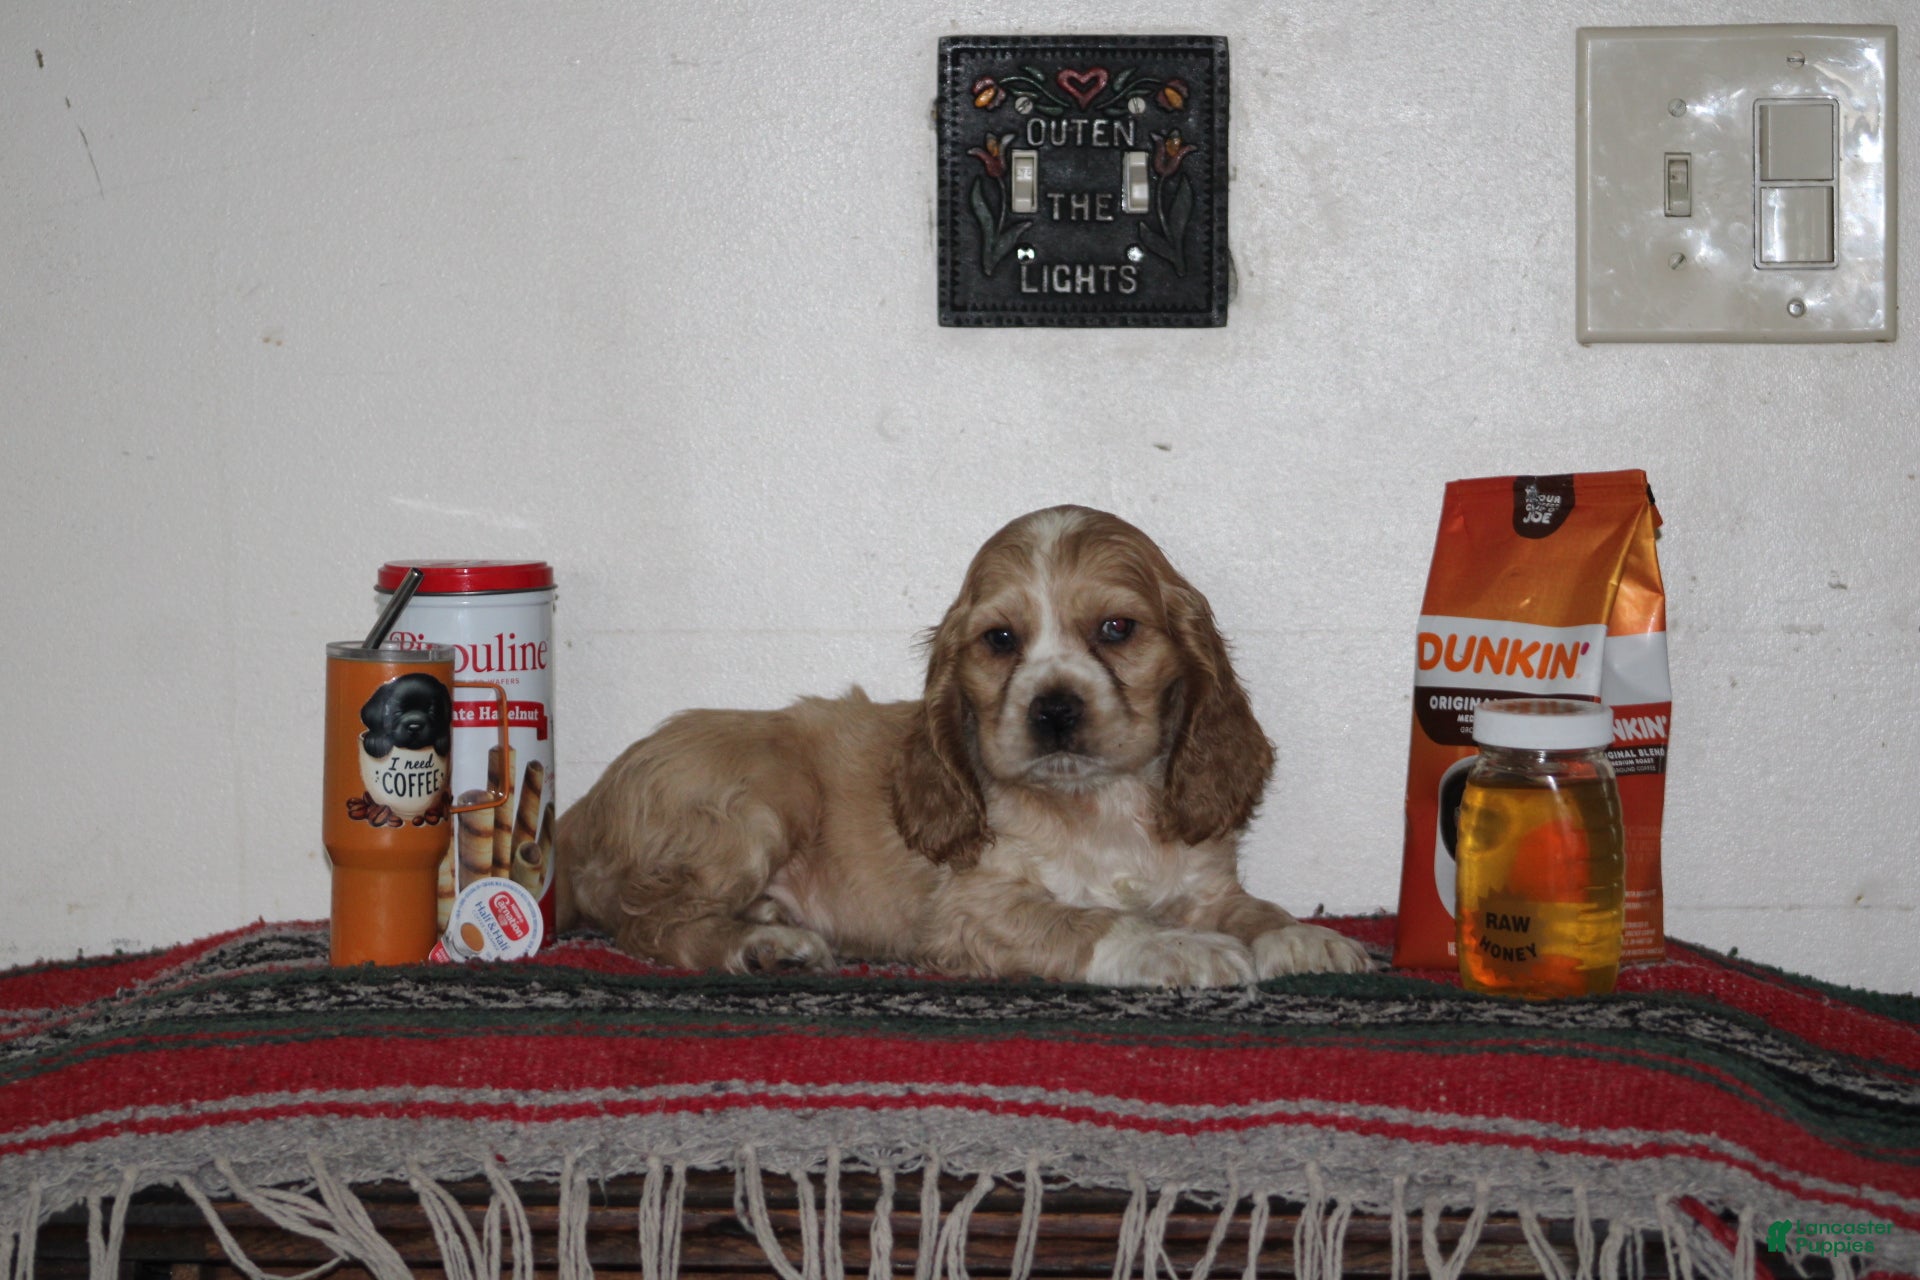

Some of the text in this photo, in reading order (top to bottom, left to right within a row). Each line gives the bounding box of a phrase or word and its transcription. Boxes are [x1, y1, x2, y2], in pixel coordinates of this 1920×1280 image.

[1026, 117, 1137, 147] OUTEN
[1047, 192, 1114, 221] THE
[1020, 264, 1138, 294] LIGHTS
[1522, 511, 1552, 524] JOE
[1416, 632, 1590, 681] DUNKIN'
[479, 706, 539, 721] Haelnut
[1429, 695, 1497, 711] ORIGIN
[1613, 715, 1667, 742] NKIN'
[387, 753, 434, 771] I need
[1638, 747, 1665, 757] BLEND
[382, 768, 441, 797] COFFEE
[493, 893, 523, 937] Carnation
[1485, 911, 1531, 933] RAW
[1479, 934, 1537, 962] HONEY
